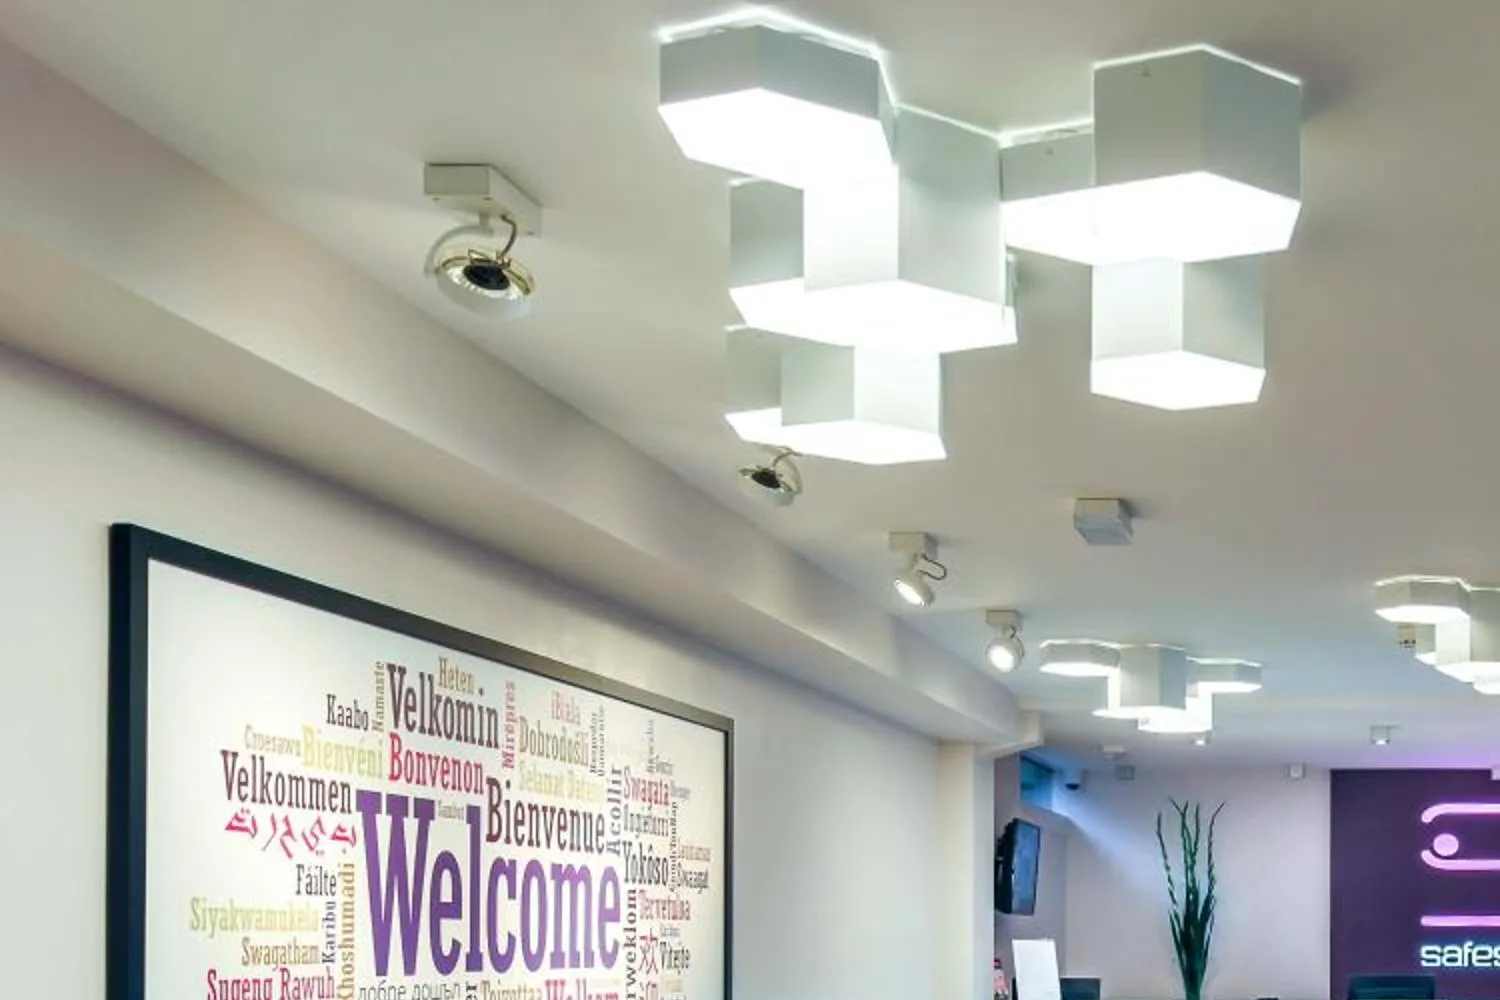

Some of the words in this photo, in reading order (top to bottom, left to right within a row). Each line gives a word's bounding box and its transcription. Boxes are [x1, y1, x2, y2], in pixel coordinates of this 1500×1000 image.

[326, 693, 369, 732] Kaabo
[386, 663, 499, 749] Velkomin
[220, 749, 353, 814] Velkommen
[388, 732, 484, 795] Bonvenon
[485, 777, 605, 855] Bienvenue
[295, 864, 337, 897] Fáilte
[356, 790, 621, 976] Welcome
[321, 901, 337, 964] Karibu
